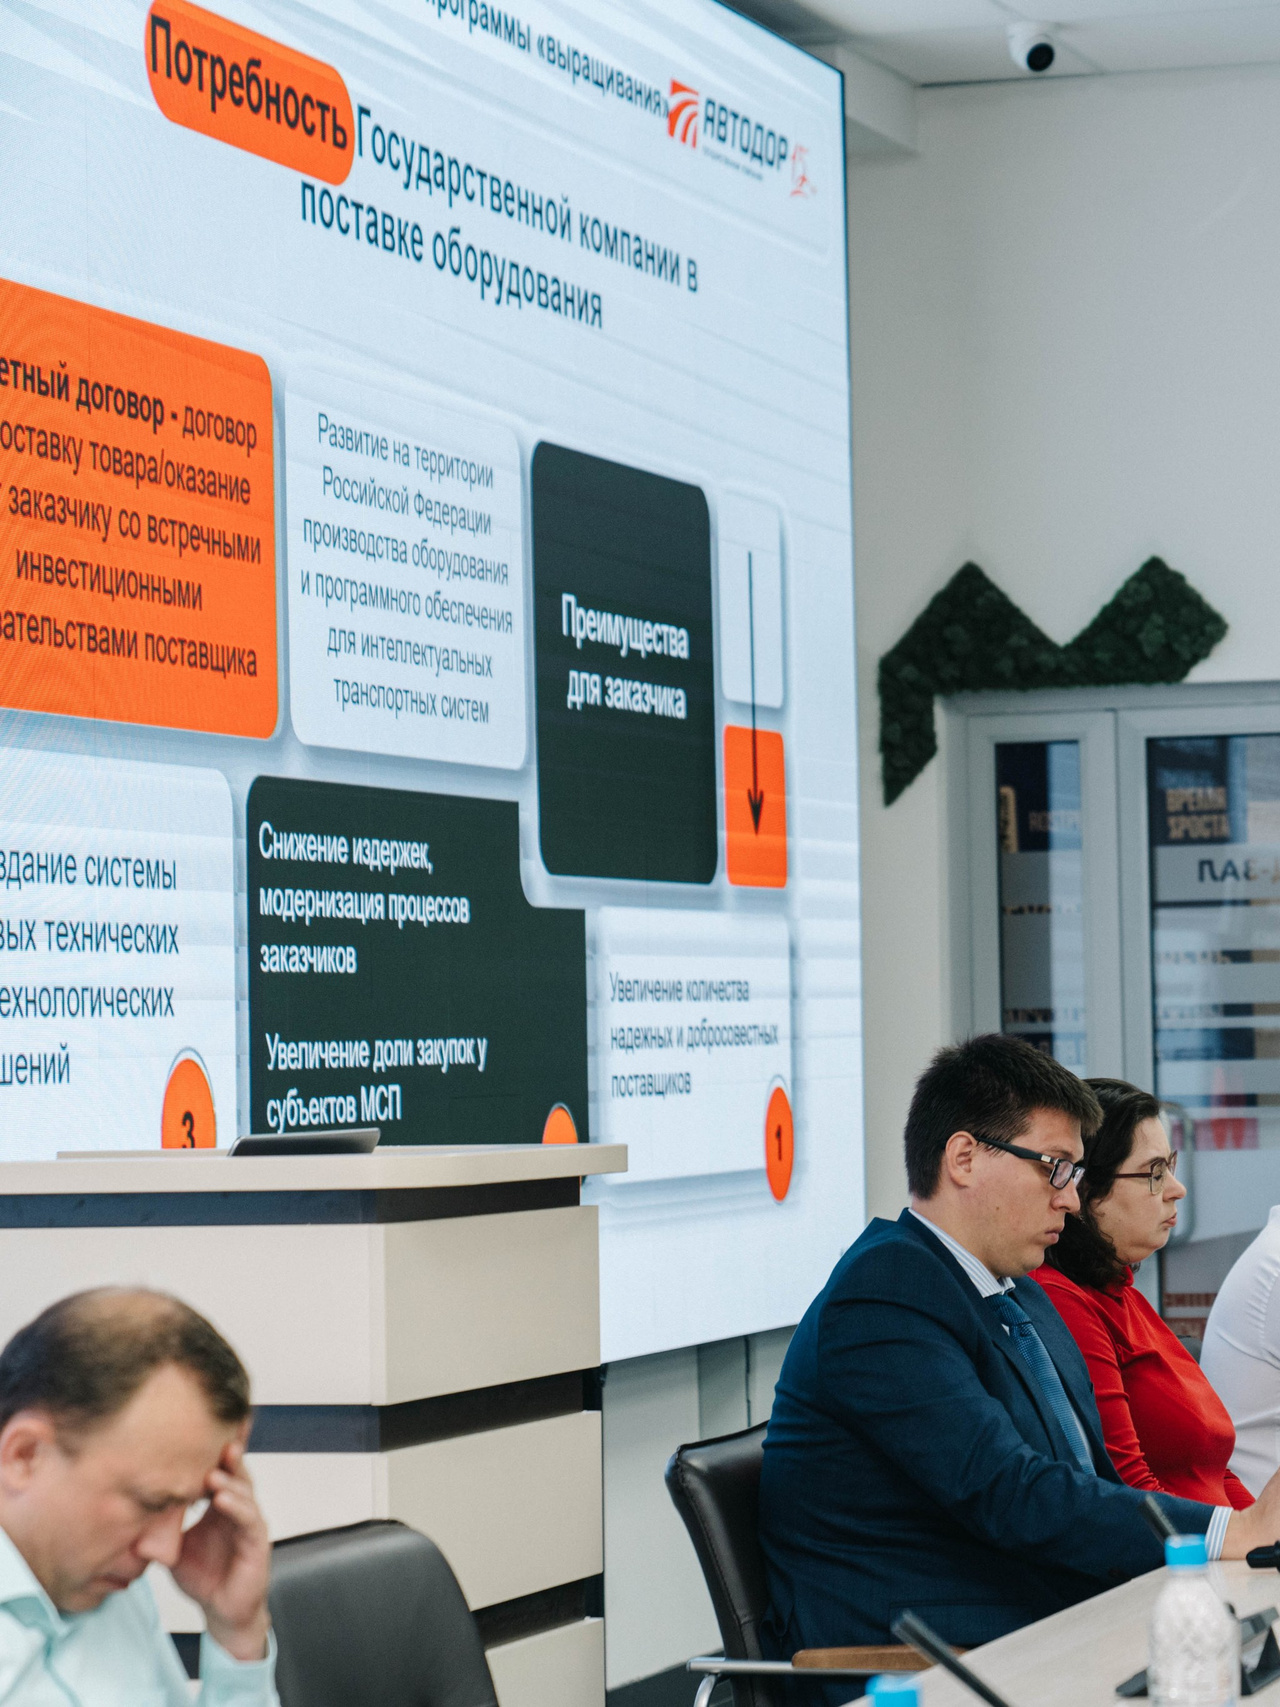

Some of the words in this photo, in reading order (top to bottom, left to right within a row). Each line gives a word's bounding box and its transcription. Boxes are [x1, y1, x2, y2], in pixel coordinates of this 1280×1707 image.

[425, 0, 531, 53] рограммы
[150, 14, 348, 151] Потребность
[357, 103, 572, 242] Государственной
[579, 211, 681, 288] компании
[687, 259, 698, 293] в
[703, 97, 789, 172] АВТОДОР
[301, 180, 424, 264] поставке
[432, 225, 603, 330] оборудования
[76, 377, 165, 435] договор
[183, 405, 257, 458] договор
[0, 420, 84, 476] оставку
[89, 440, 251, 506] товара/оказание
[318, 412, 389, 461] Развитие
[393, 439, 410, 468] на
[414, 445, 494, 491] территории
[8, 484, 113, 543] заказчику
[118, 508, 141, 540] со
[147, 513, 262, 565] встречными
[322, 465, 409, 516] Российской
[413, 488, 492, 536] Федерации
[303, 517, 408, 564] производства
[411, 538, 509, 587] оборудования
[16, 548, 203, 612] инвестиционными
[300, 568, 310, 595] и
[315, 572, 421, 616] программного
[425, 589, 513, 634] обеспечения
[0, 608, 138, 661] ательствами
[144, 632, 258, 679] поставщика
[561, 592, 690, 660] Преимущества
[327, 627, 356, 657] для
[361, 632, 493, 679] интеллектуальных
[333, 677, 437, 719] транспортных
[440, 695, 489, 724] систем
[566, 669, 601, 711] для
[604, 675, 687, 720] заказчика
[85, 855, 177, 890] системы
[258, 820, 349, 864] Снижение
[352, 836, 434, 875] издержек,
[259, 886, 385, 926] модернизация
[388, 892, 471, 929] процессов
[44, 919, 180, 954] технических
[260, 943, 357, 974] заказчиков
[0, 985, 175, 1018] ехнологических
[608, 971, 683, 1002] Увеличение
[686, 978, 750, 1002] количества
[265, 1032, 370, 1071] Увеличение
[373, 1037, 414, 1073] доли
[416, 1037, 475, 1074] закупок
[478, 1037, 488, 1072] у
[610, 1025, 673, 1054] надежных
[676, 1025, 684, 1048] и
[686, 1017, 779, 1054] добросовестных
[266, 1088, 357, 1134] субъектов
[360, 1083, 402, 1121] МСП
[611, 1071, 692, 1100] поставщиков
[181, 1110, 195, 1149] 3
[775, 1124, 782, 1161] 1
